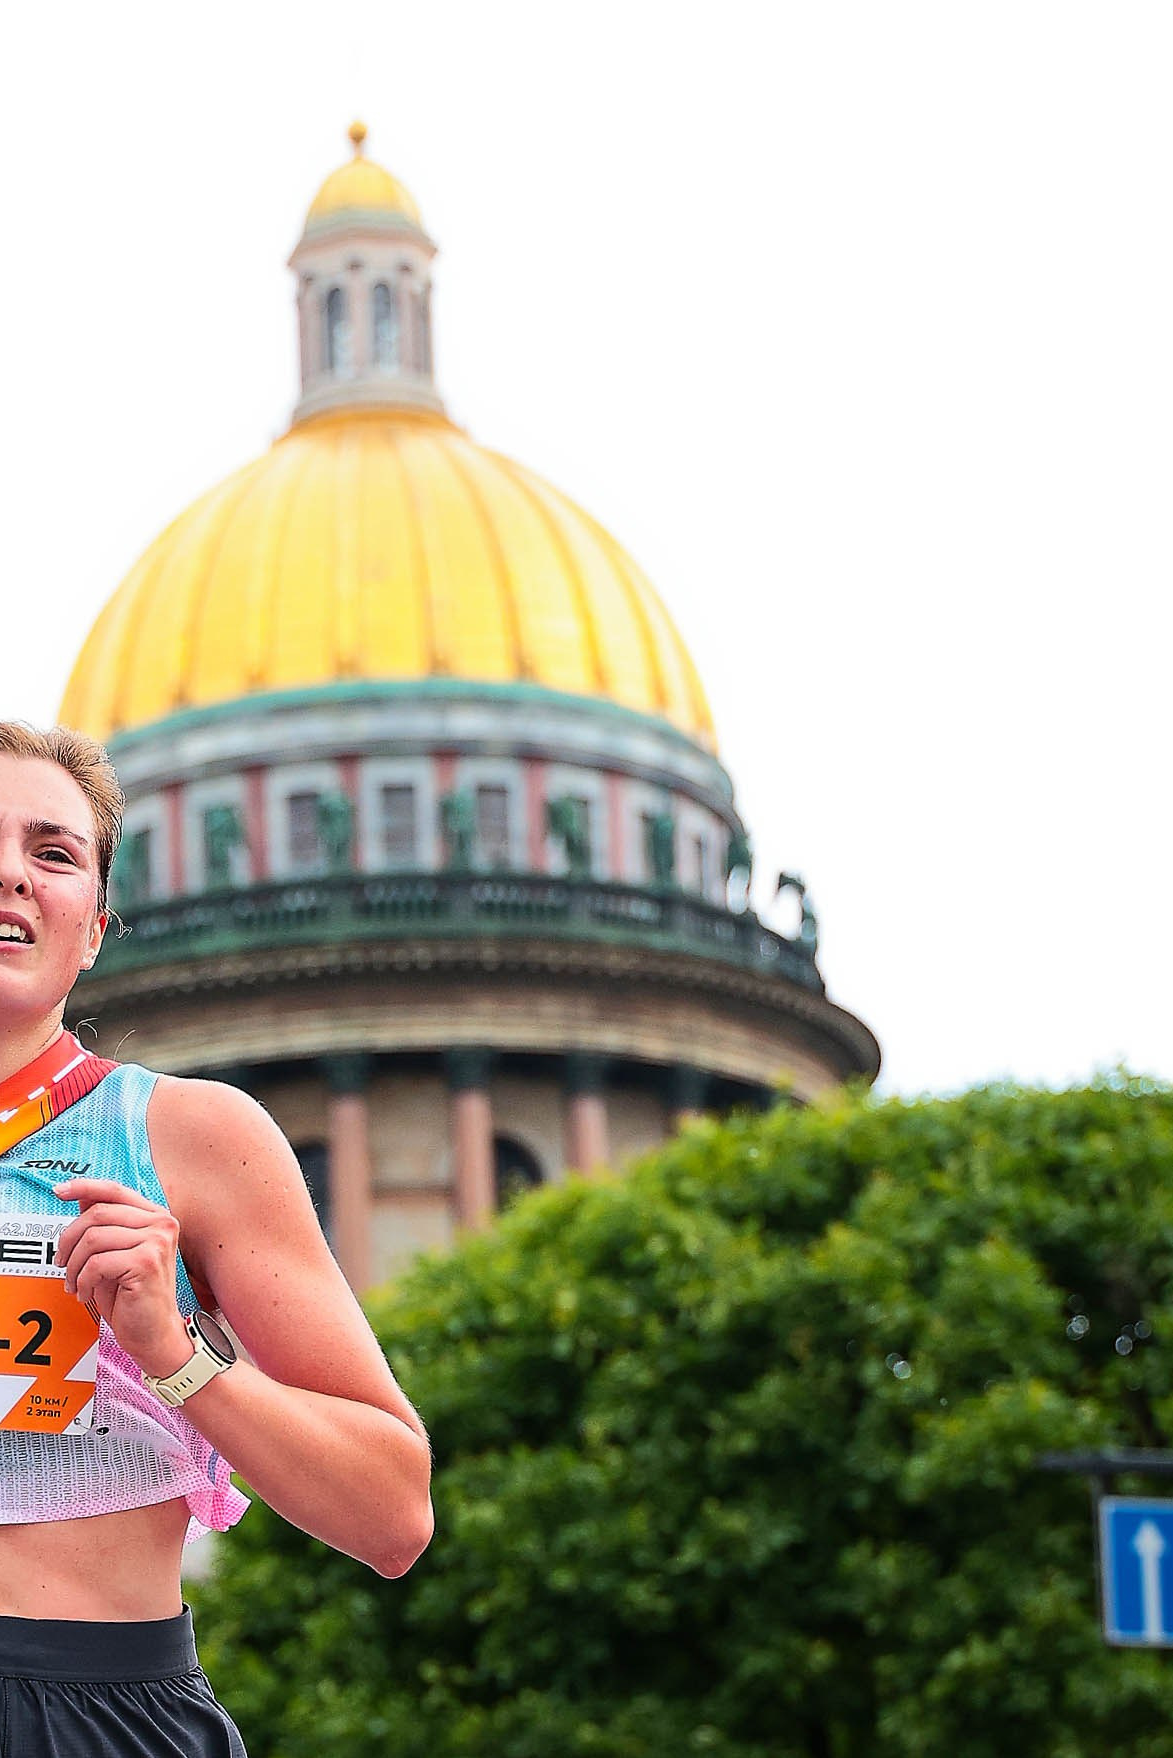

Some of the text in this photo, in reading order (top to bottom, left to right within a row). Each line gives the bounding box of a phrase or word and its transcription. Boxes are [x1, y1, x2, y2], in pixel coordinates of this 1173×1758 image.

[18, 1159, 91, 1175] SONU
[30, 1395, 42, 1405] 10
[26, 1406, 61, 1418] 2 этап
